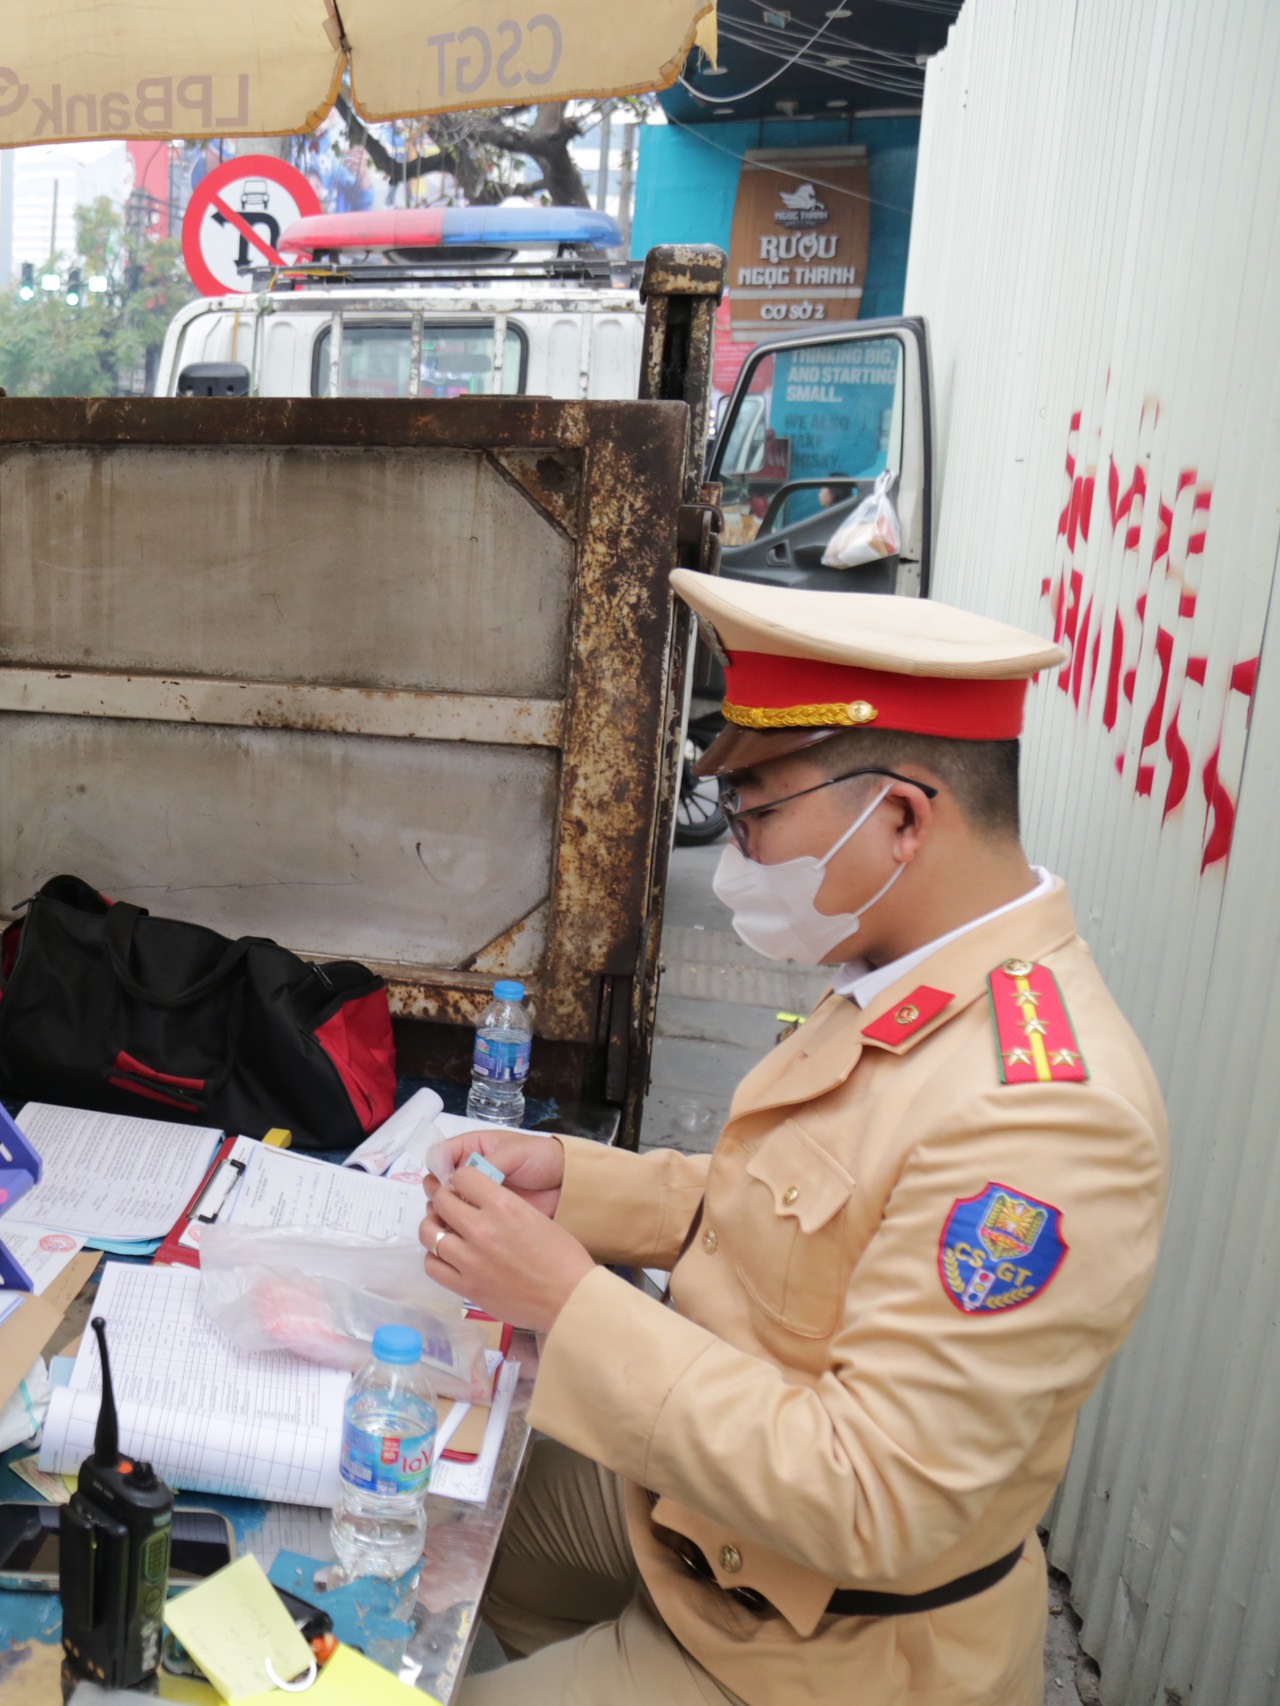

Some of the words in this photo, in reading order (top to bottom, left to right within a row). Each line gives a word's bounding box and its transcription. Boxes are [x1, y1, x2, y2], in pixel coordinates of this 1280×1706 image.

[760, 231, 838, 264] RƯỢU
[738, 266, 790, 289] NGỌC
[794, 265, 856, 285] THANH
[760, 303, 787, 319] CƠ
[788, 299, 813, 319] SỞ
[814, 304, 825, 319] 2
[791, 348, 862, 364] THINKING
[865, 348, 895, 367] BIG,
[788, 366, 820, 383] AND
[822, 367, 897, 385] STARTING
[786, 384, 843, 403] SMALL.
[954, 1242, 987, 1269] CS
[996, 1262, 1033, 1287] GT
